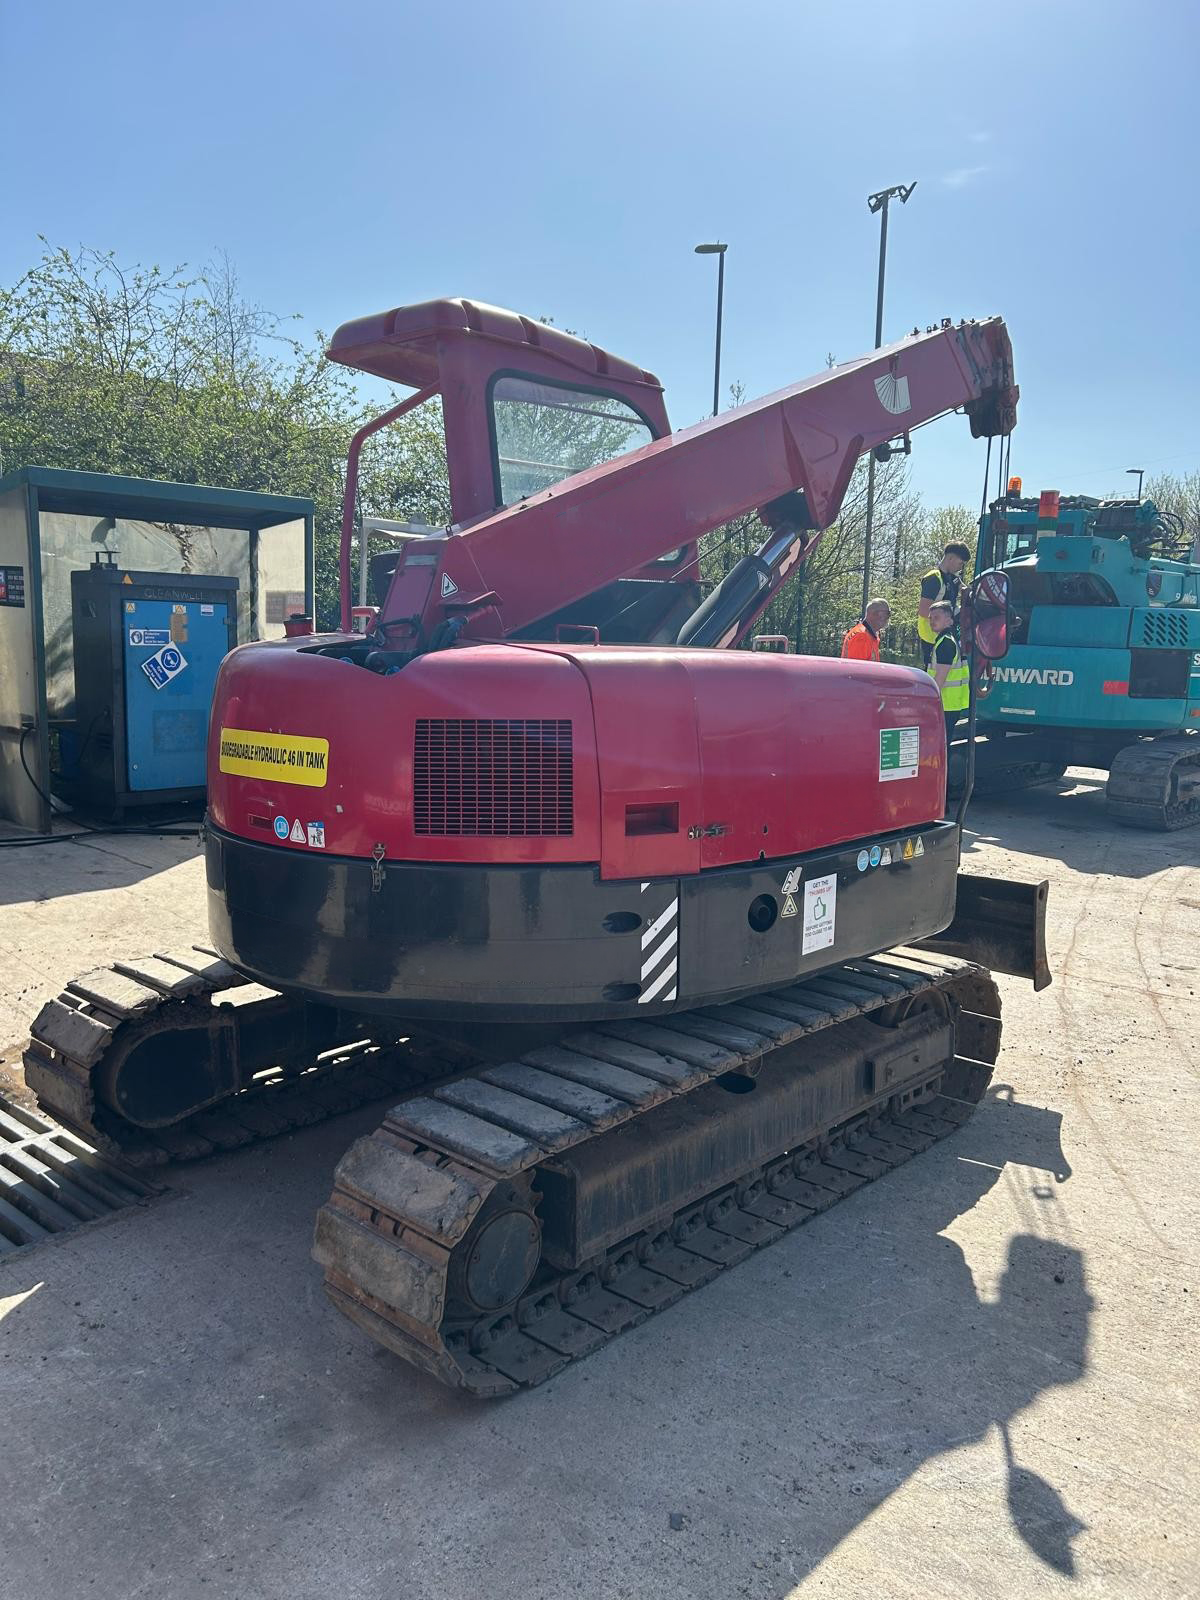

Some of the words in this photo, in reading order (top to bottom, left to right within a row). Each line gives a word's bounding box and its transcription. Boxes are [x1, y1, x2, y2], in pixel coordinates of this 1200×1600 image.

[254, 745, 287, 765] HYDRAULIC
[288, 750, 296, 766] 46
[297, 750, 304, 767] IN
[305, 751, 325, 769] TANK
